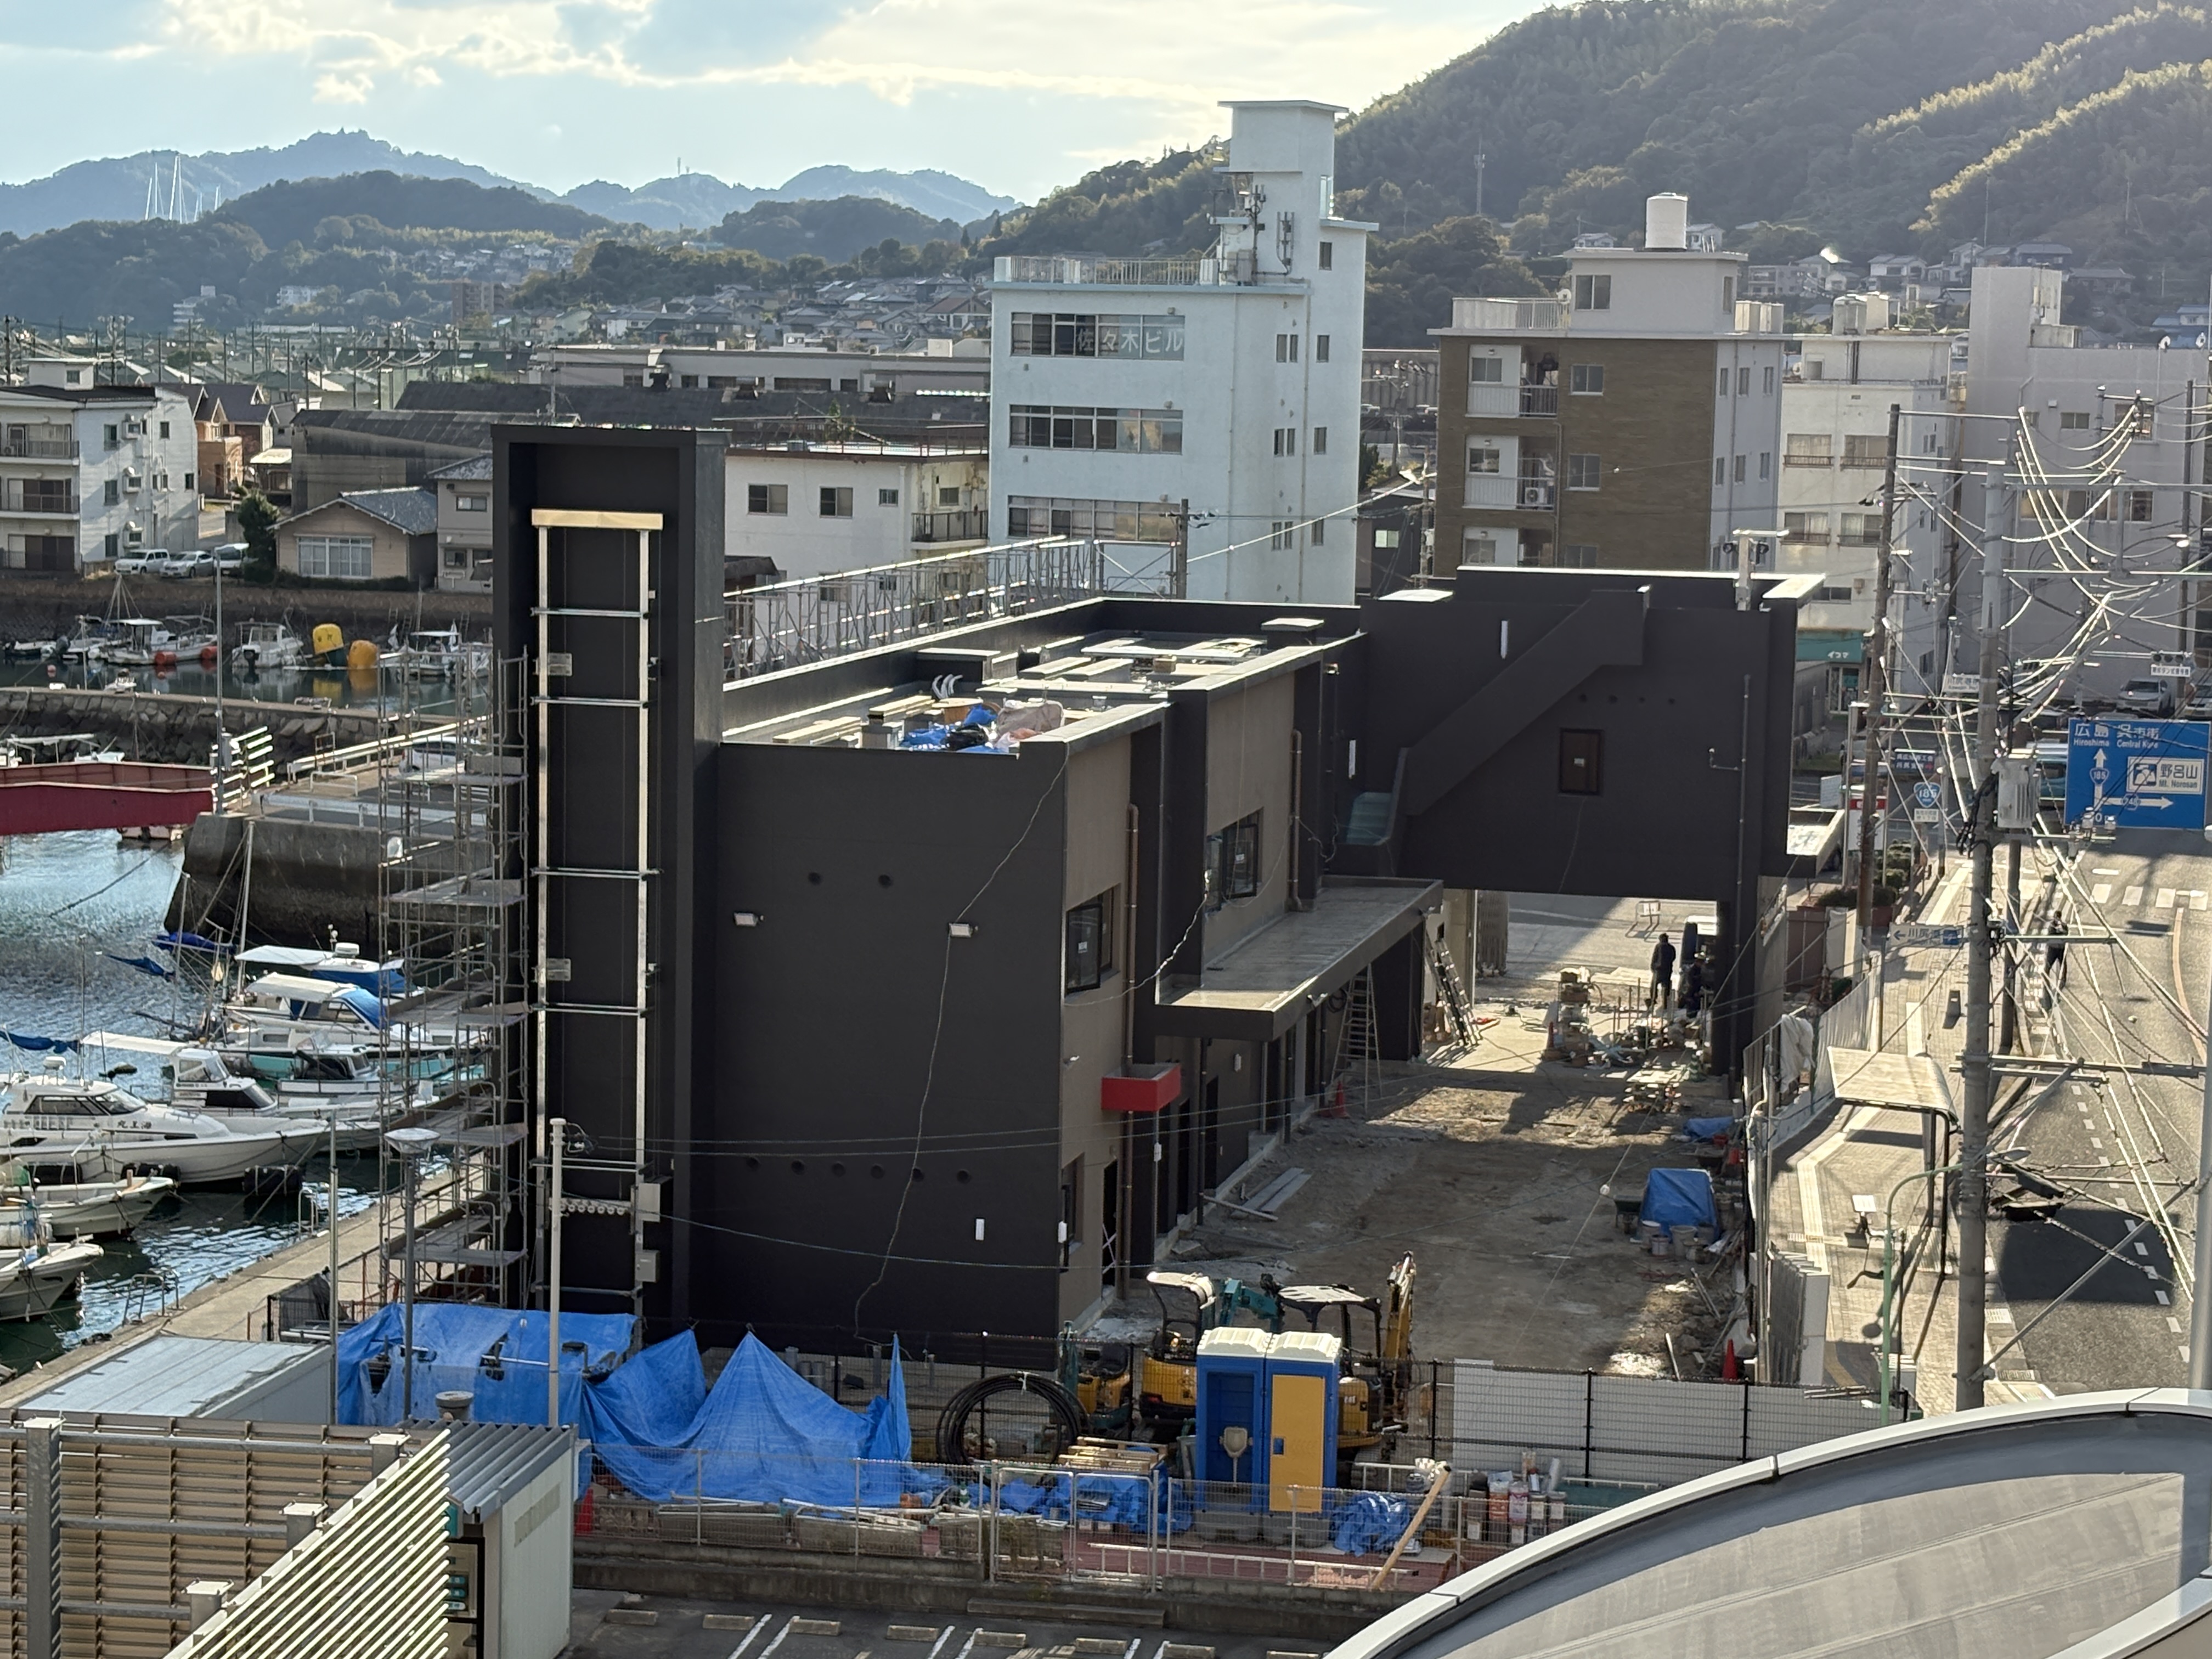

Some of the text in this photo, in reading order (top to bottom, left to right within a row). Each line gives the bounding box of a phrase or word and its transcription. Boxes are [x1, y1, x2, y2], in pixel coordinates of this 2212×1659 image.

[1077, 329, 1183, 353] 佐々木ビル
[2074, 723, 2109, 737] 広島
[2074, 738, 2109, 747] Hiroshima
[2093, 771, 2106, 780] 185
[2160, 764, 2198, 779] 野呂山
[1919, 788, 1937, 798] 185
